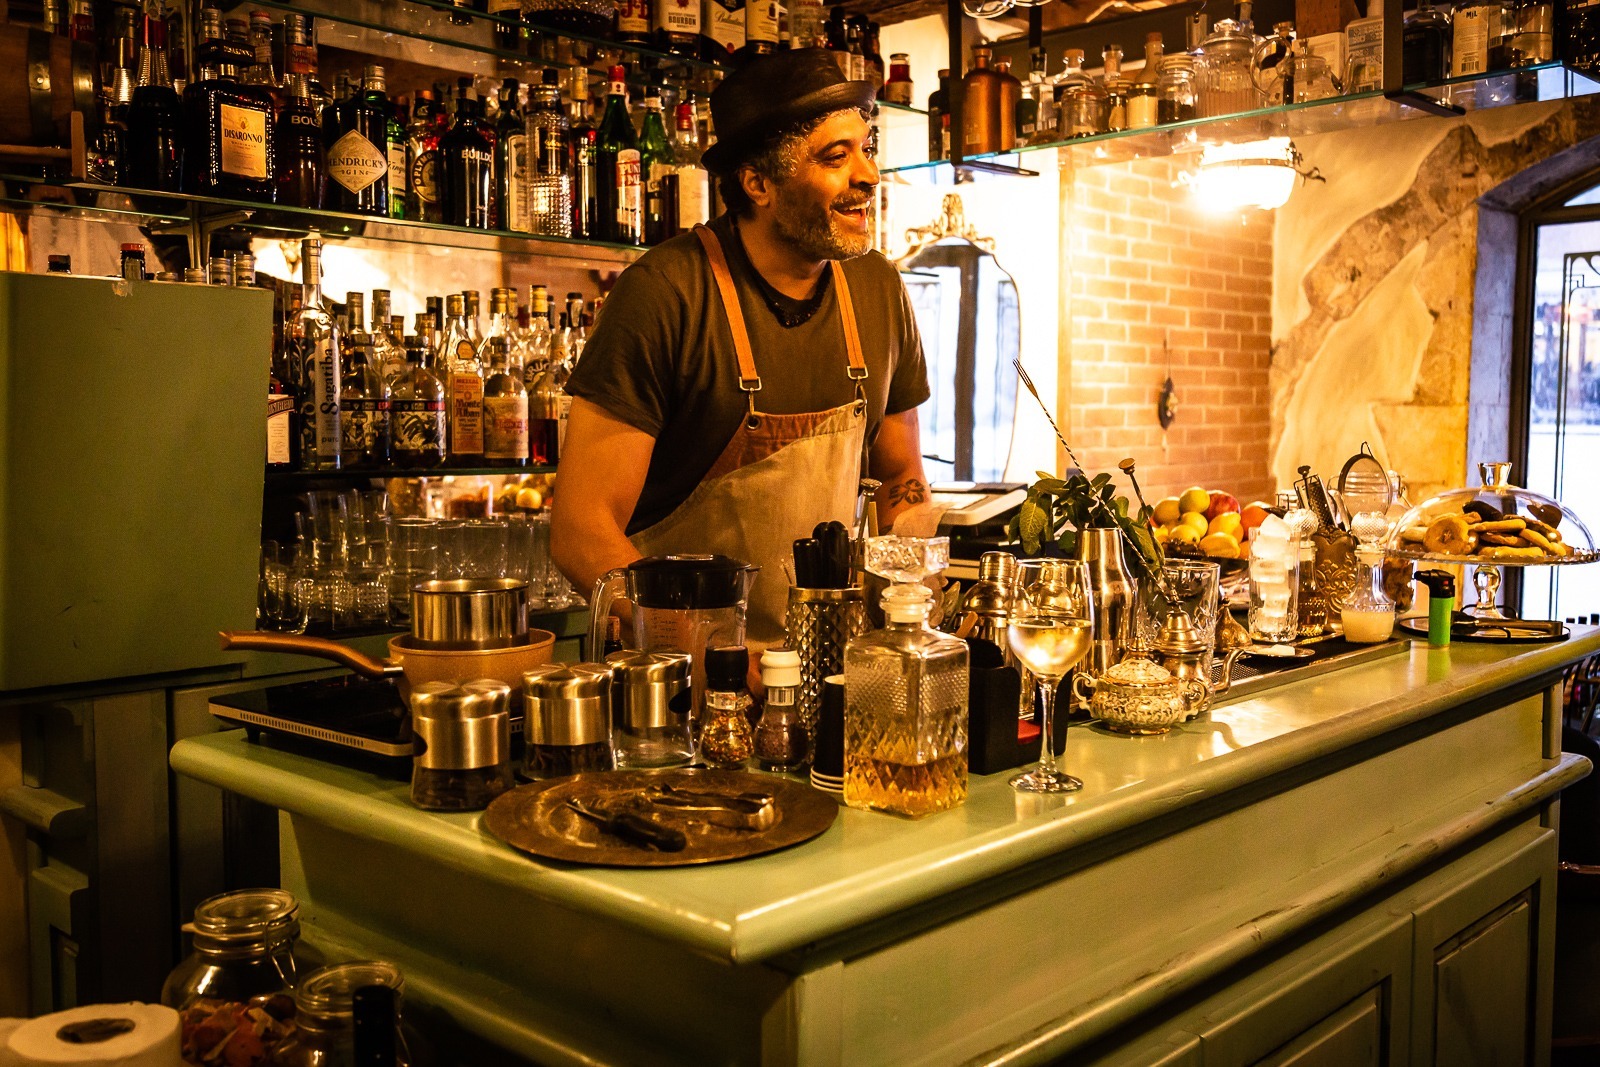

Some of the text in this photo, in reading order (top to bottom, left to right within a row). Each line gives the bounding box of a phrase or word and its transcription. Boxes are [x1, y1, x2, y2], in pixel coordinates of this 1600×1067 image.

[668, 15, 697, 26] BOURBON
[224, 128, 263, 144] DISARONNO
[319, 348, 338, 416] Sagatiba
[455, 398, 481, 409] Monte
[455, 407, 481, 419] Alban
